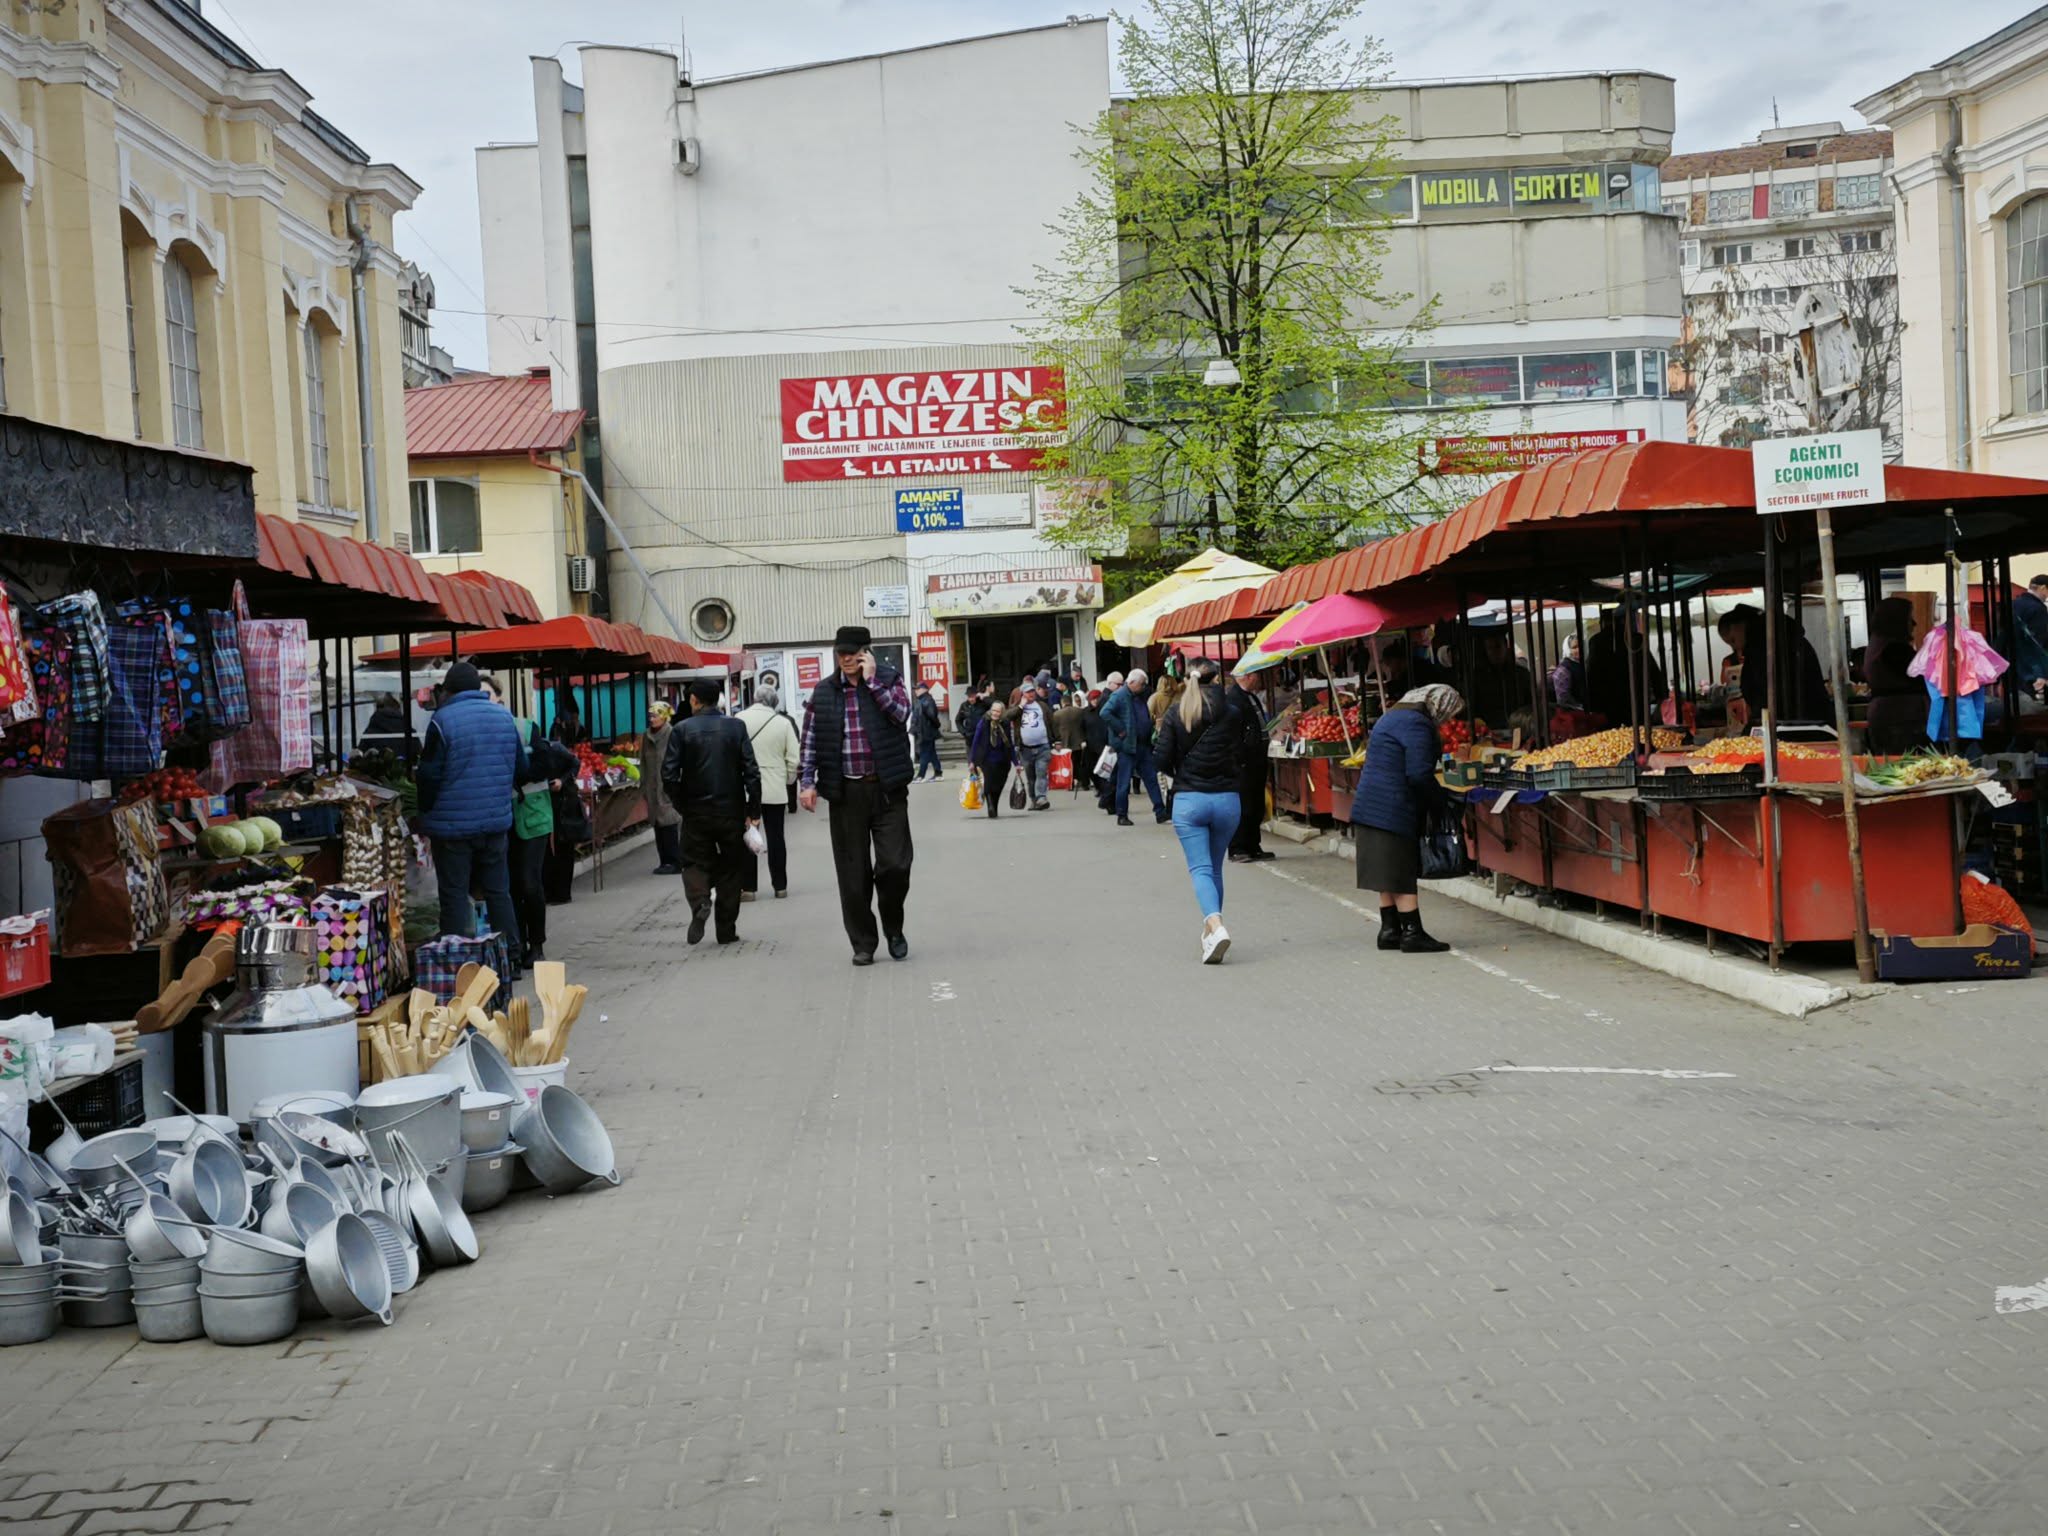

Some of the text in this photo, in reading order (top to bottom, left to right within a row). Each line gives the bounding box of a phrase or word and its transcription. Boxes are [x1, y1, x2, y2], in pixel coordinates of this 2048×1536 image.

[1421, 172, 1601, 206] MOBILA SORTEM
[812, 369, 1033, 410] MAGAZIN
[795, 400, 1054, 441] CHINEZESC
[942, 438, 985, 449] LENJERIE
[1580, 434, 1618, 447] PRODUSE
[1789, 443, 1842, 463] AGENTI
[872, 456, 982, 476] LA ETAJUL 1
[1774, 462, 1859, 484] ECONOMICI
[898, 489, 960, 505] AMANET
[1767, 488, 1870, 507] SECTOR LEGUME FRUCTE
[912, 512, 948, 531] 0,10%
[939, 571, 1009, 590] FARMACIE
[922, 664, 945, 681] ETAJ
